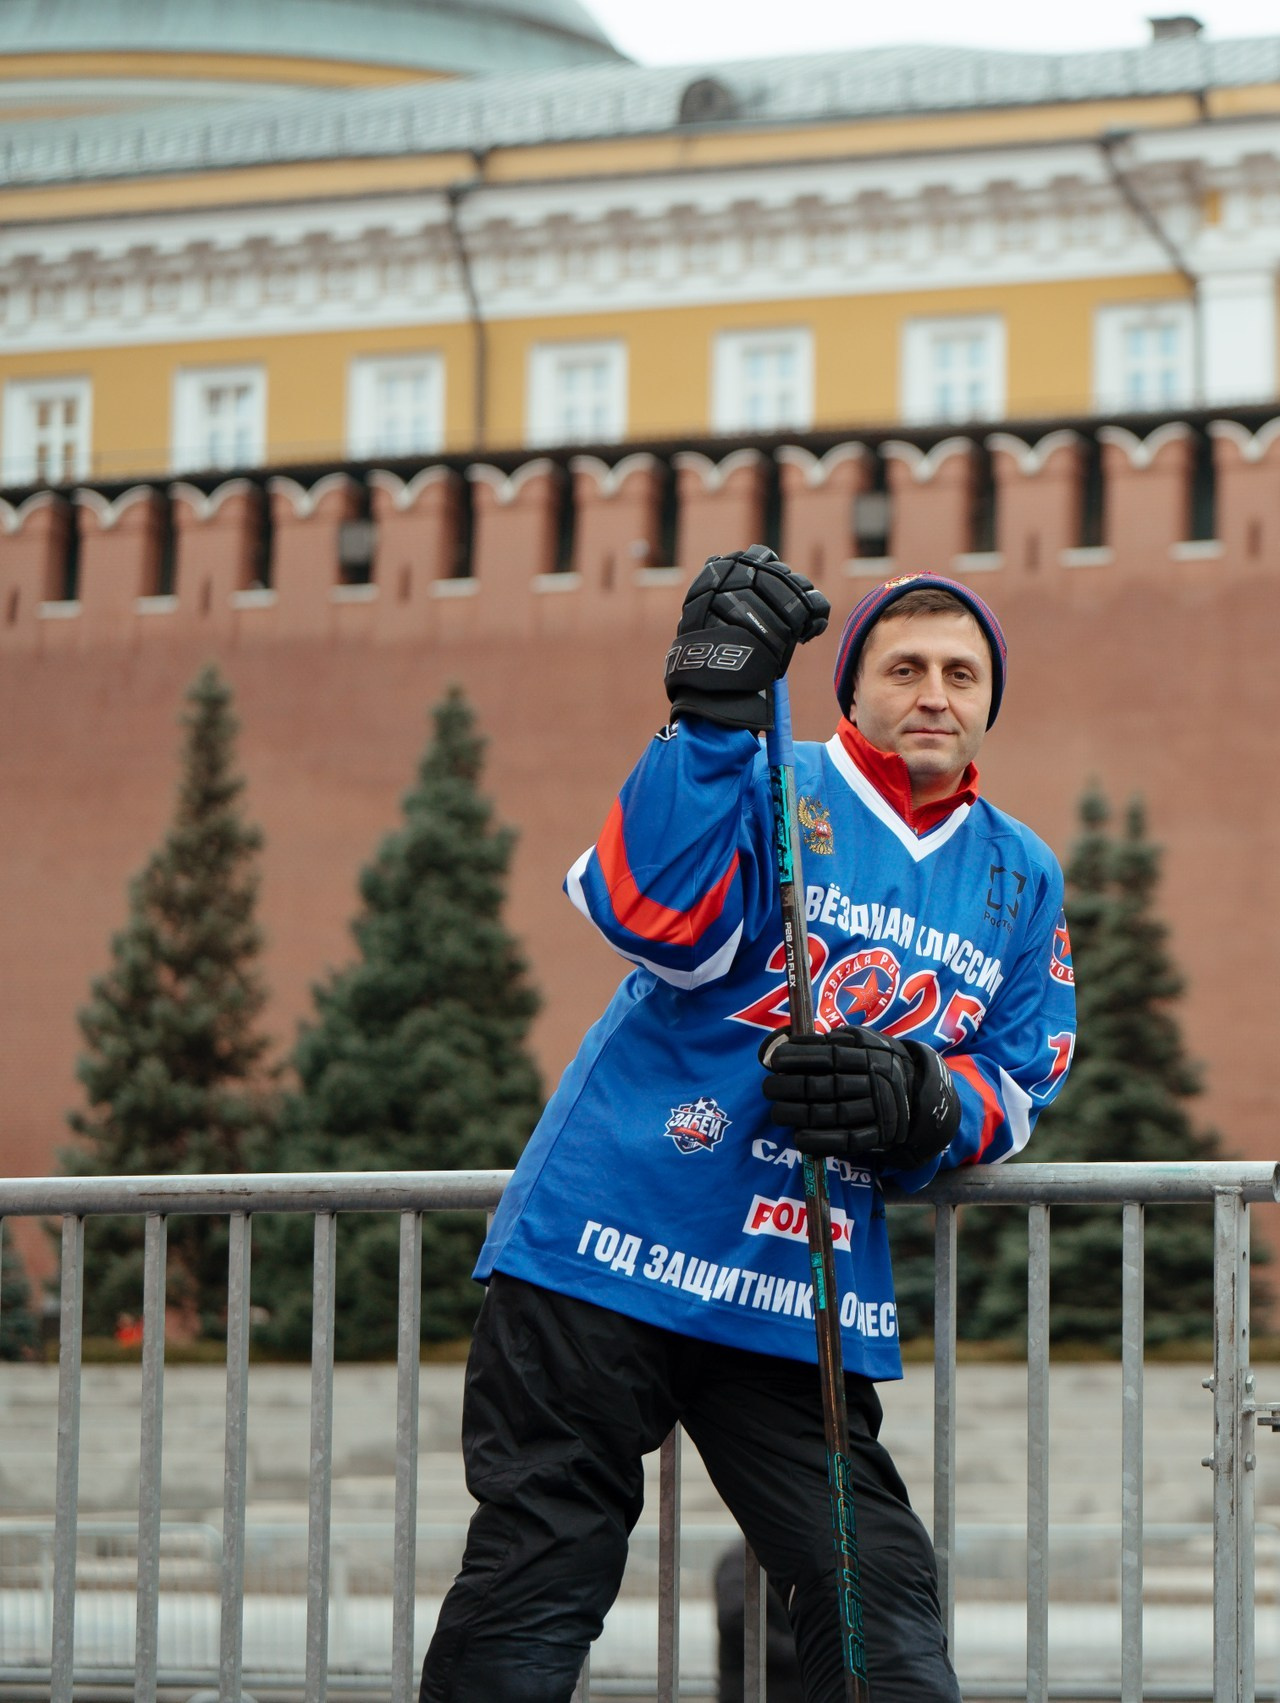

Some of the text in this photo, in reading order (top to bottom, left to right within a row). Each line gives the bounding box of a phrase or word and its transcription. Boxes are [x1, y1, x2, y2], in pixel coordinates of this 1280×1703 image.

[807, 882, 916, 949] ВЁЗДНАЯ
[789, 963, 797, 988] FLEX
[576, 1220, 643, 1277] ГОД
[643, 1244, 816, 1320] ЗАЩИТНИК
